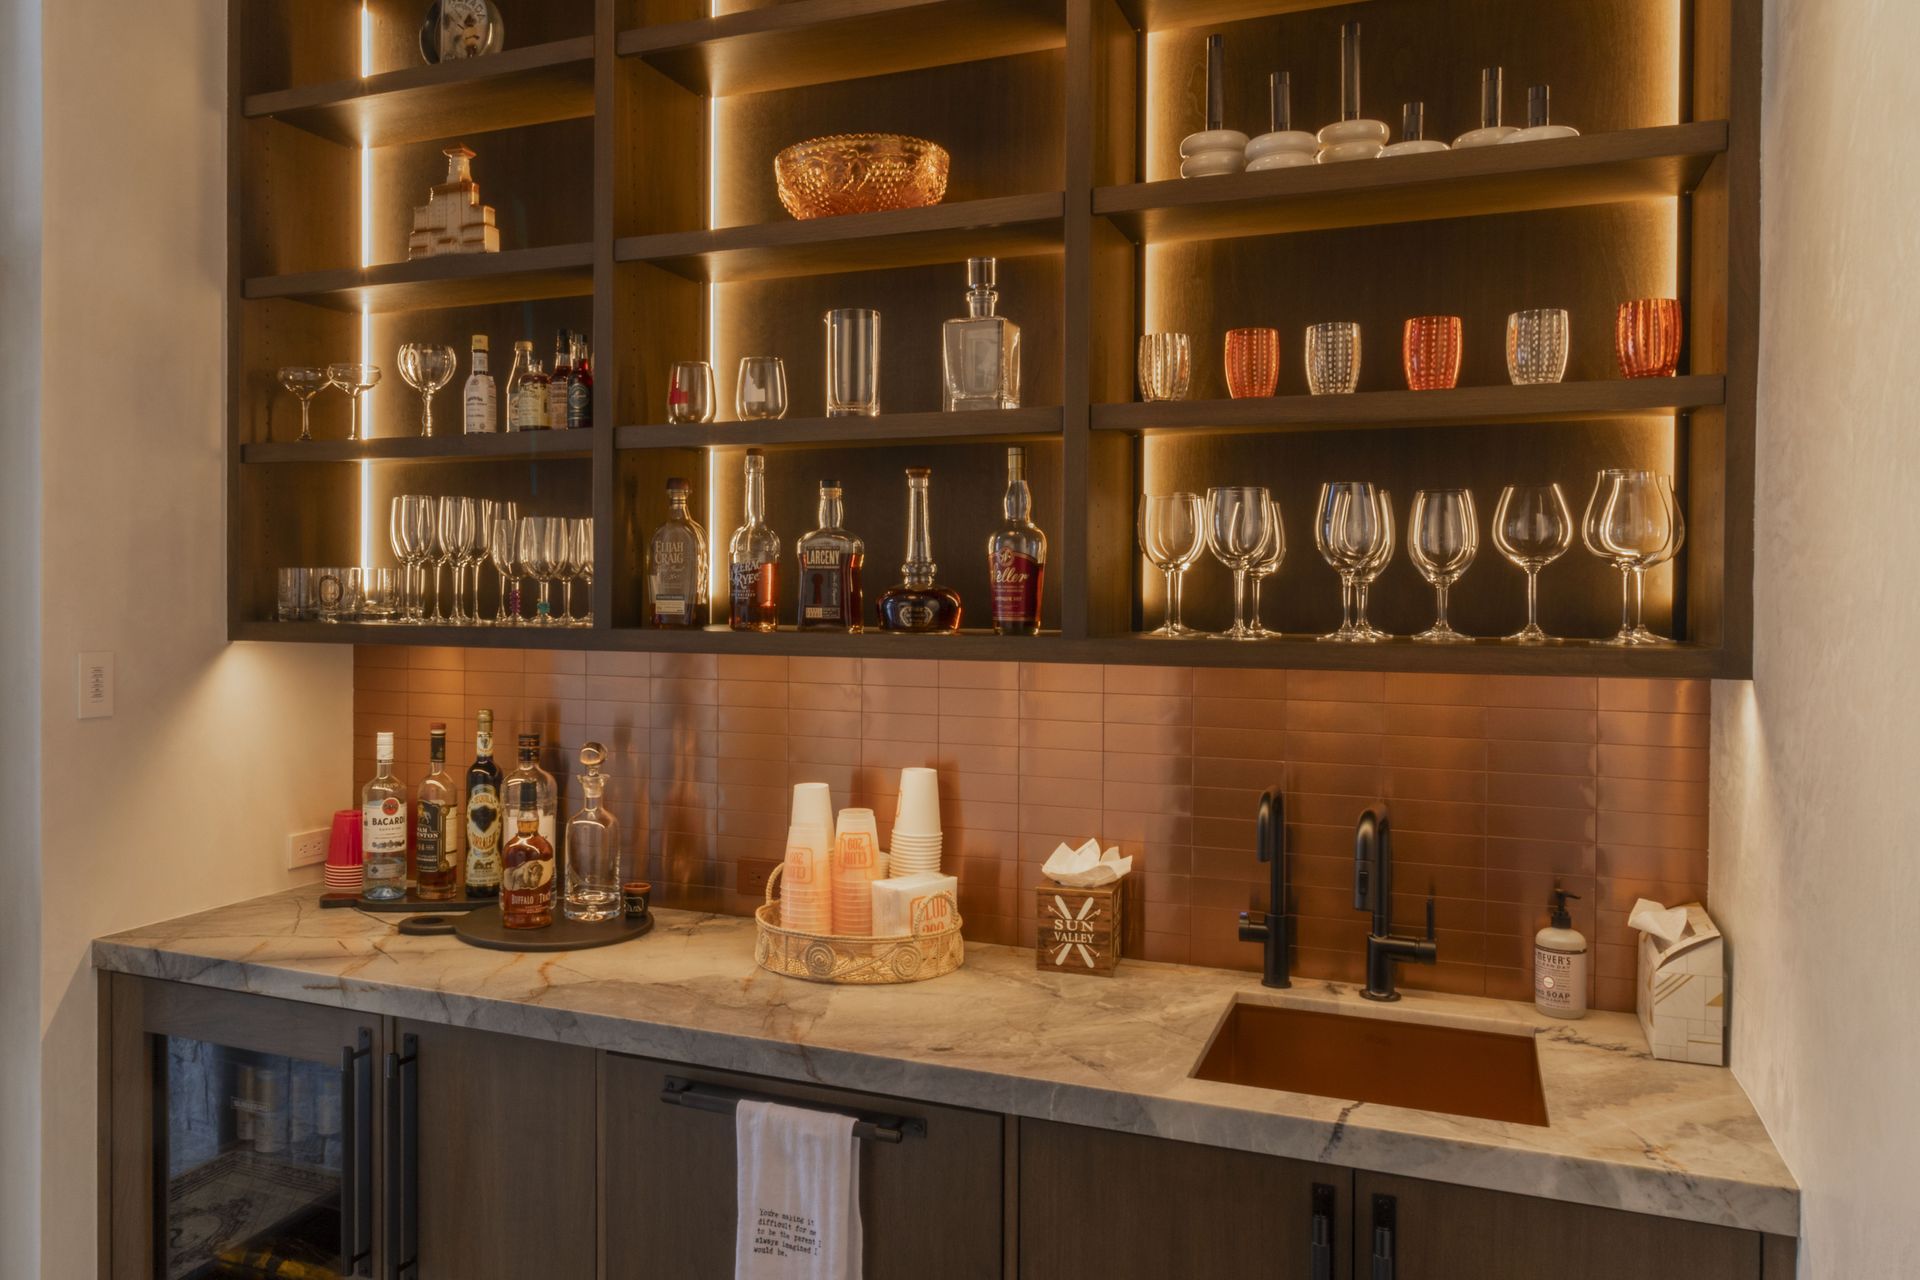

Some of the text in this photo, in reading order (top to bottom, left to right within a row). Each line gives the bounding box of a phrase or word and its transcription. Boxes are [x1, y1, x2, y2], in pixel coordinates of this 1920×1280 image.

[655, 540, 684, 552] ELIJAH
[655, 552, 684, 564] CRAIG
[806, 550, 840, 565] LARCENY
[511, 894, 534, 904] BUFFALO
[1054, 919, 1095, 932] SUN
[1054, 931, 1095, 944] VALLEY
[1546, 991, 1570, 1000] SOAP
[760, 1208, 778, 1218] You're
[758, 1218, 791, 1230] difficult
[796, 1225, 807, 1233] for
[780, 1231, 789, 1239] the
[794, 1235, 815, 1245] parent
[754, 1246, 773, 1255] would
[755, 1237, 778, 1246] always
[782, 1241, 811, 1254] imagined
